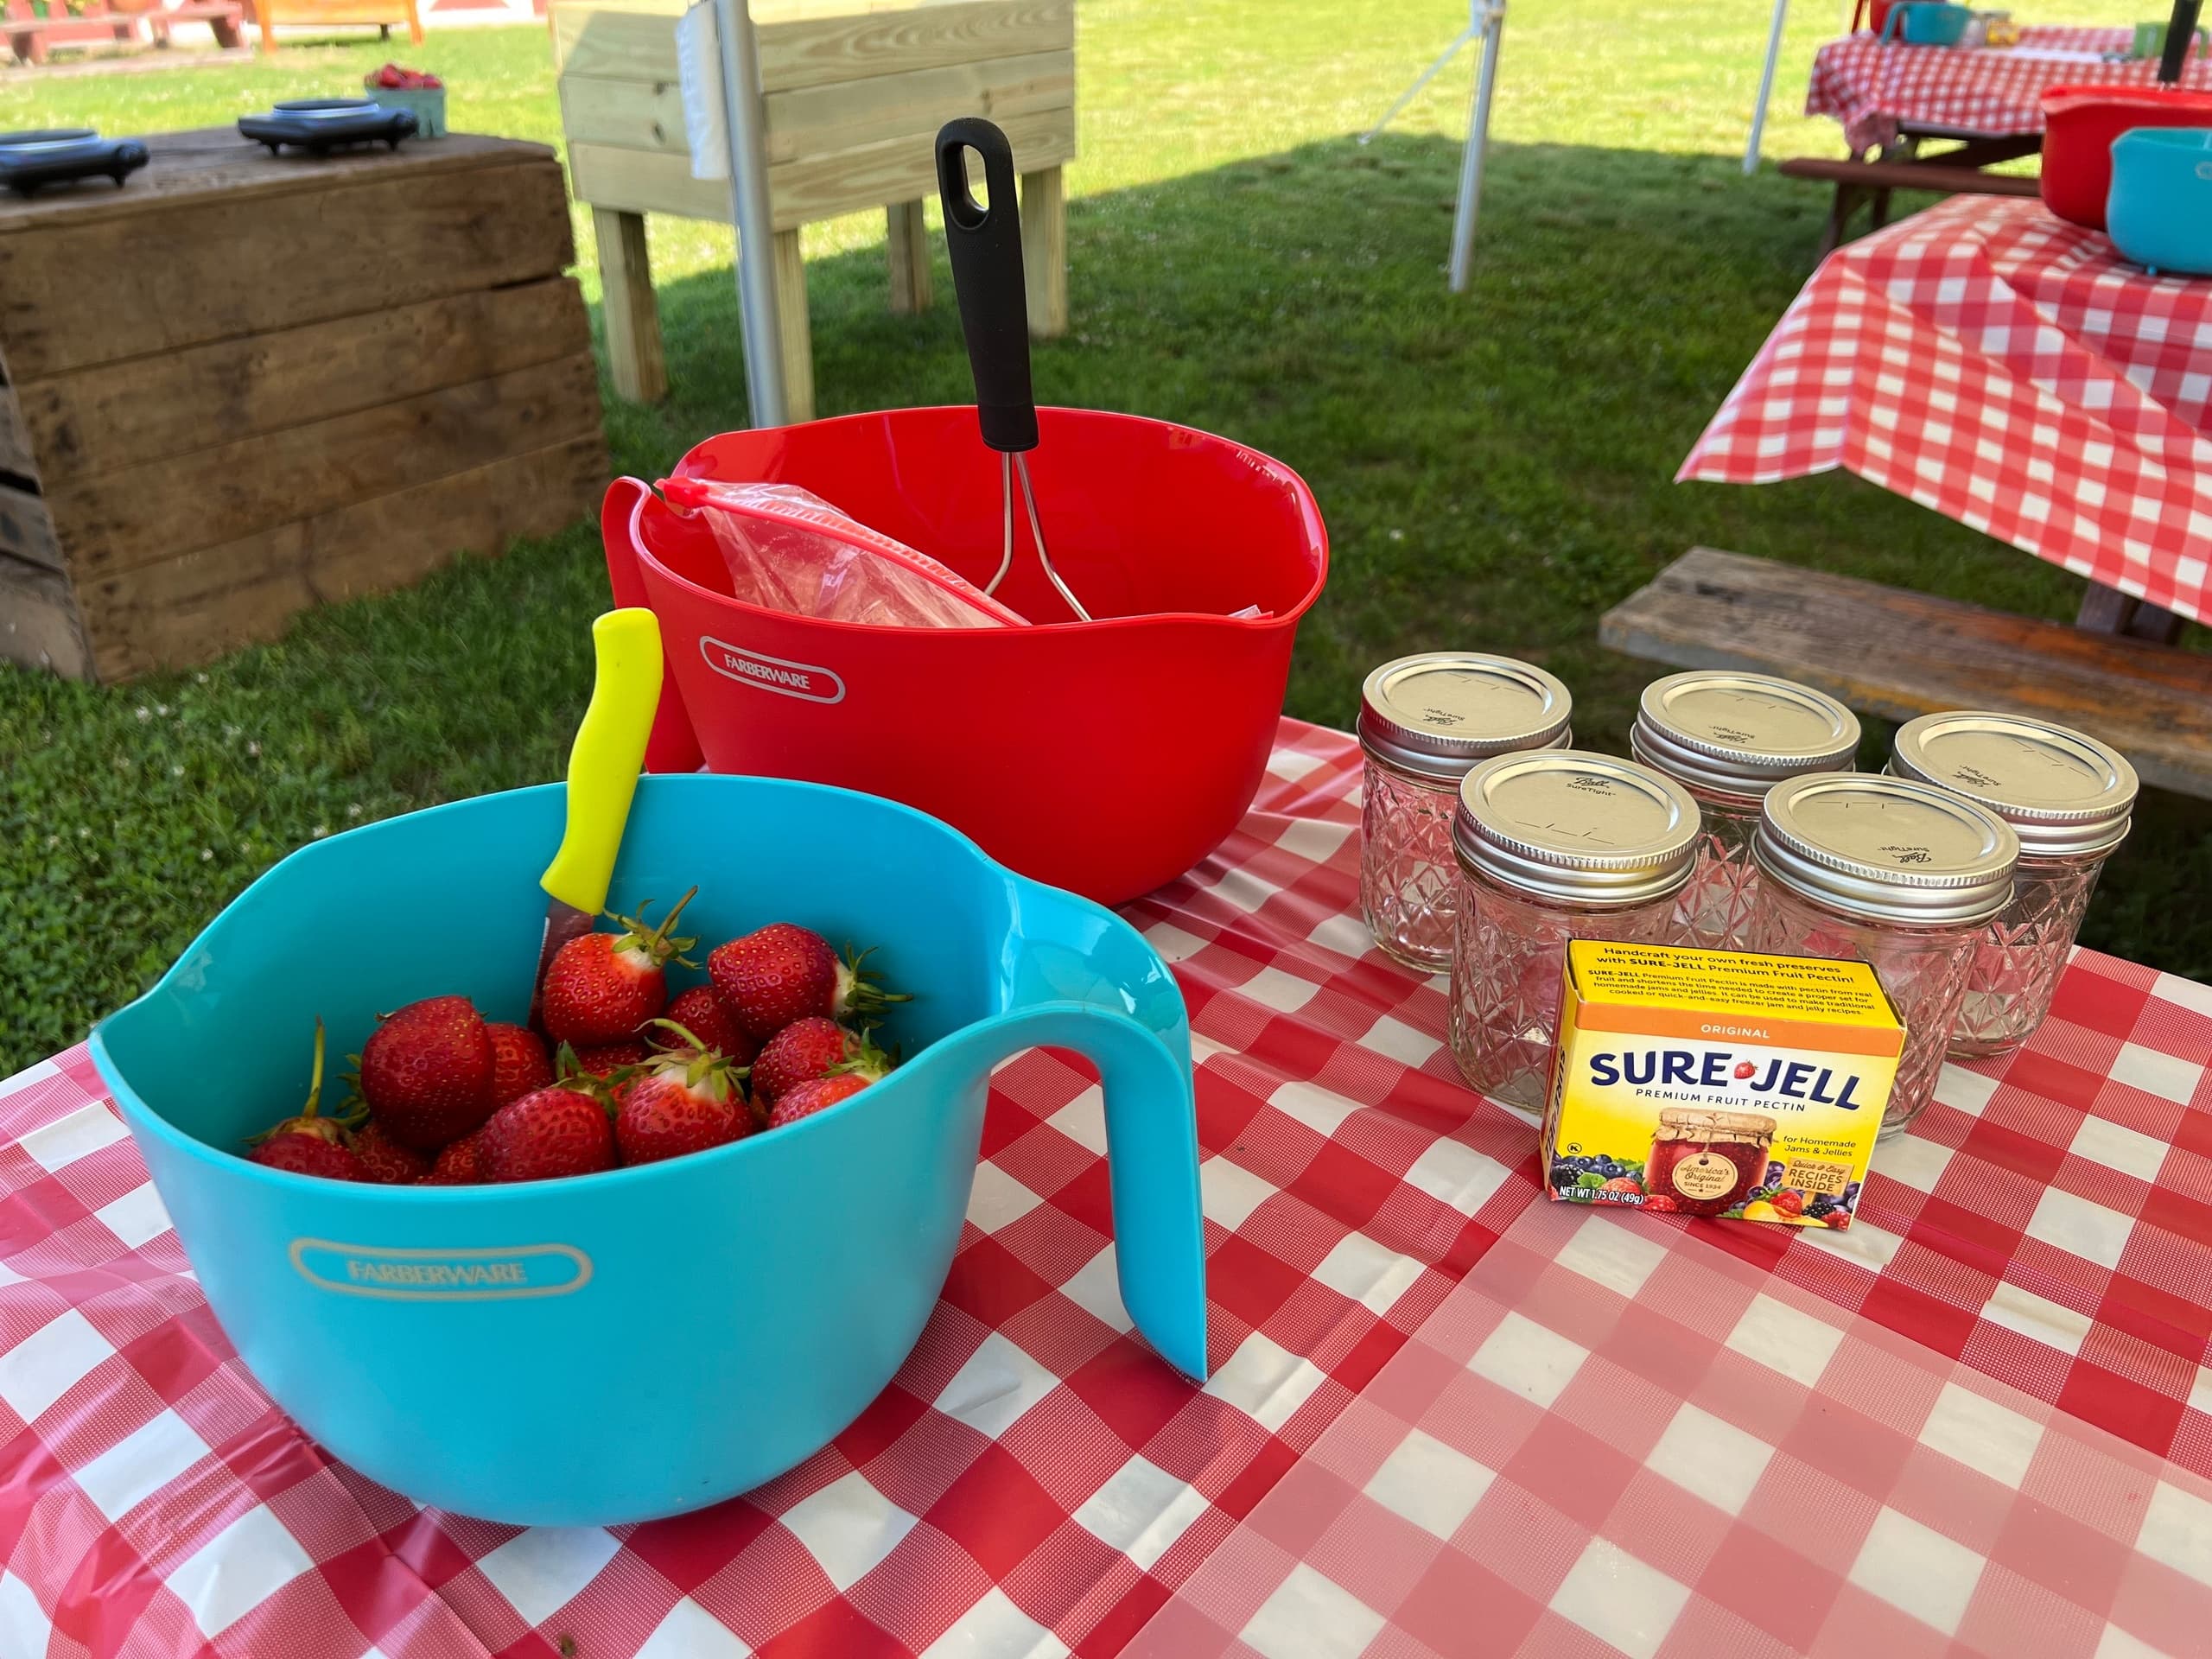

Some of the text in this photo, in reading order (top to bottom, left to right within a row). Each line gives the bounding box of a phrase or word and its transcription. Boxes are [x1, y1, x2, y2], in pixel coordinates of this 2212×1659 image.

[724, 654, 810, 690] FARBERWARE
[1573, 777, 1610, 788] Ball
[1891, 852, 1932, 863] Ball
[1605, 948, 1670, 958] Handcraft
[1777, 963, 1841, 973] preserves
[1630, 958, 1706, 970] SURE-JELL
[1708, 964, 1770, 976] Premium
[1773, 970, 1804, 979] Fruit
[1808, 974, 1854, 983] Pectin!
[1637, 978, 1677, 987] shortens
[1827, 1001, 1875, 1010] traditional
[1700, 1024, 1770, 1039] ORIGINAL
[1590, 1051, 1860, 1111] SURE JELL
[1636, 1089, 1806, 1112] PREMIUM FRUIT PECTIN
[1784, 1145, 1809, 1154] Jams
[1800, 1137, 1856, 1147] Homemade
[1681, 1164, 1730, 1175] America's
[1793, 1160, 1816, 1169] Quick
[1826, 1165, 1846, 1175] Easy
[1685, 1172, 1726, 1182] Original
[1789, 1169, 1843, 1184] RECIPES
[1790, 1179, 1835, 1192] INSIDE
[1560, 1185, 1643, 1205] NET WT 1.75 OZ (49g)
[347, 1260, 528, 1285] FARBERWARE
